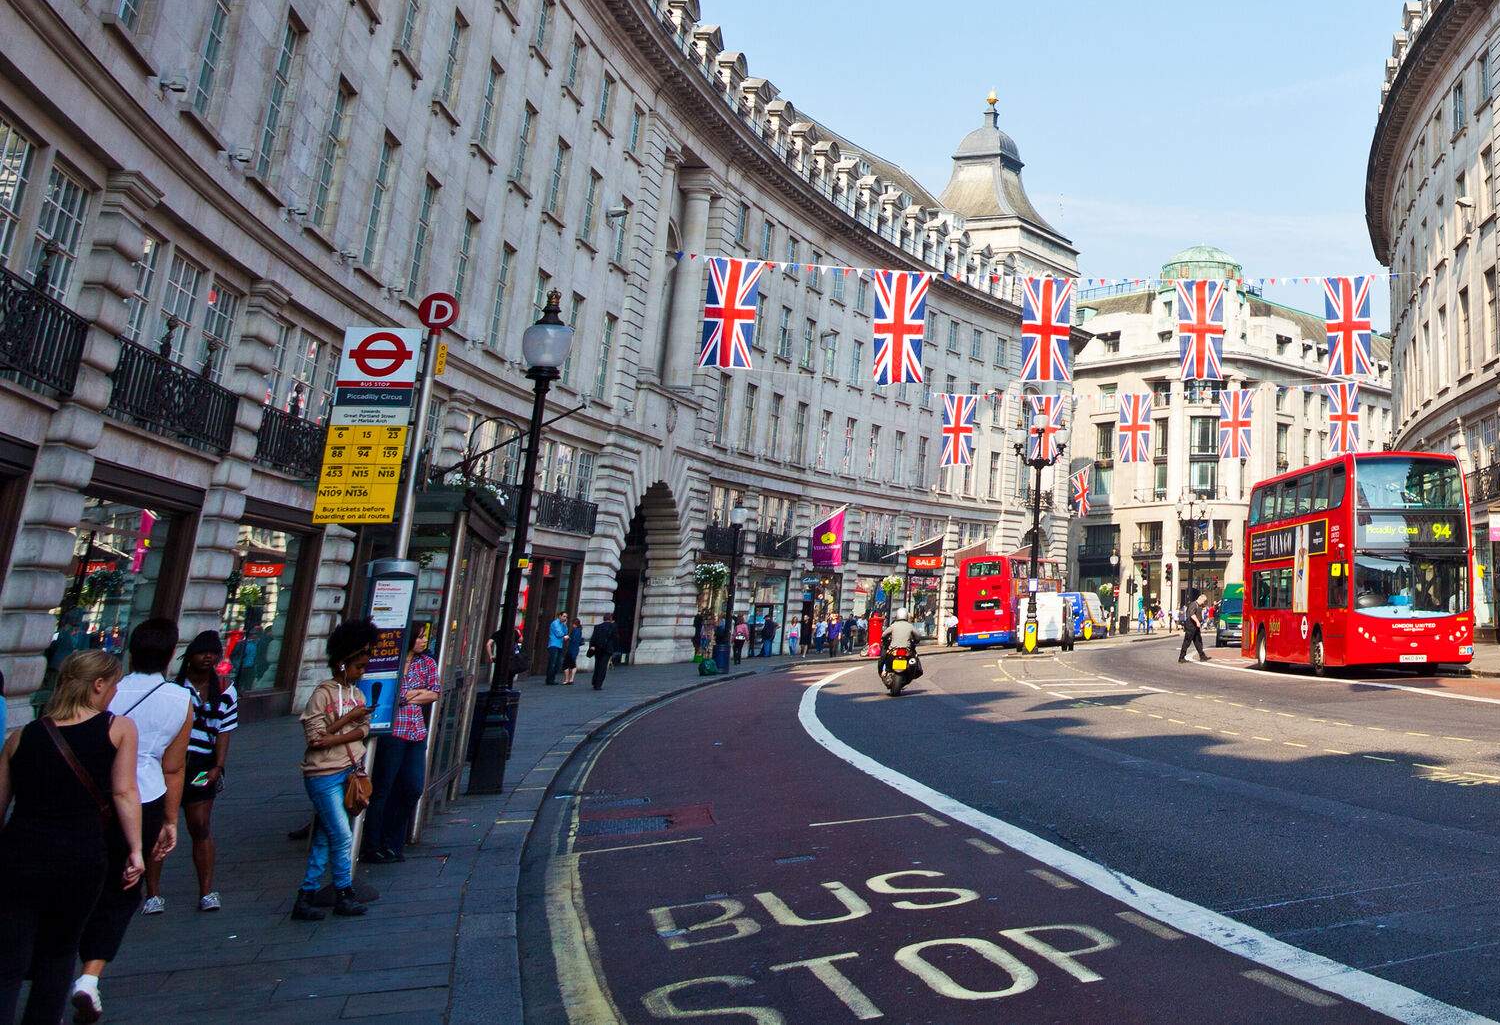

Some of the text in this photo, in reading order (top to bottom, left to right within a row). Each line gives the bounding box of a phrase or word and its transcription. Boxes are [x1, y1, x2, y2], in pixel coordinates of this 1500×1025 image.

[428, 300, 453, 323] D
[346, 393, 403, 401] Piccadilly Circus
[337, 431, 398, 439] 6 15 23
[331, 450, 398, 458] 88 94 159
[326, 469, 395, 478] 453 N15 N18
[318, 489, 368, 497] N109 N136
[1432, 523, 1452, 540] 94
[1270, 532, 1292, 555] MANGO
[646, 870, 981, 951] BUS
[640, 924, 1120, 1025] STOP
